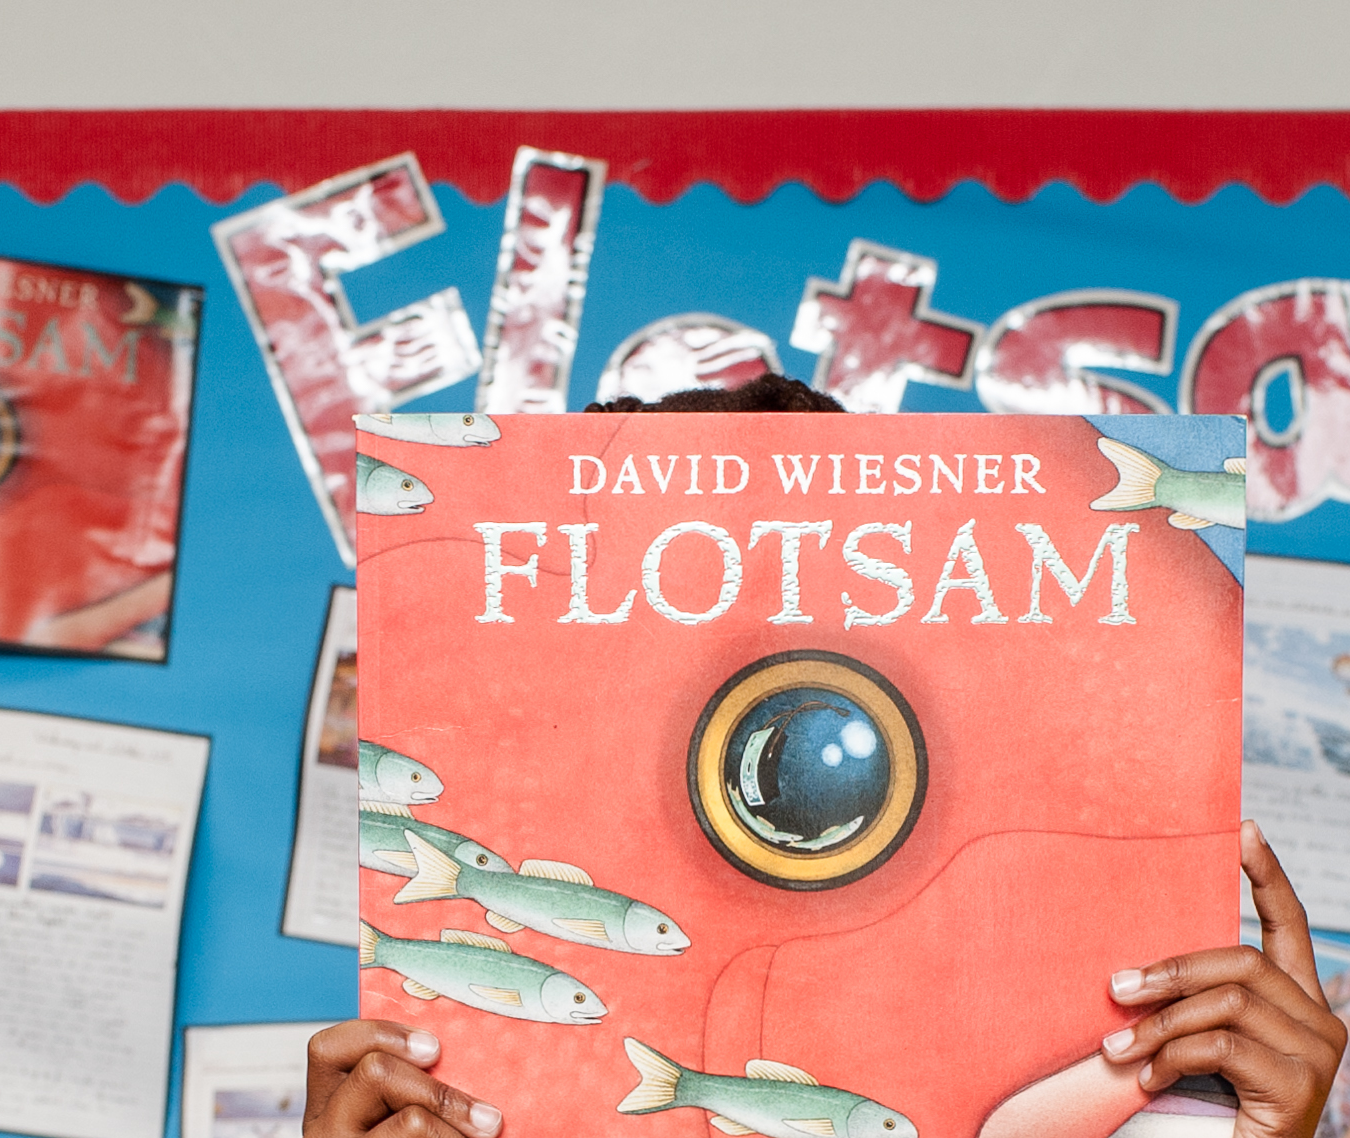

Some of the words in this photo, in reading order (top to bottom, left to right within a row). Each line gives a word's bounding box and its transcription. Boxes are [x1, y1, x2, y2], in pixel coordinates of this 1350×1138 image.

[568, 453, 750, 495] DAVID
[771, 453, 1047, 495] WIESNER
[472, 518, 1141, 630] FLOTSAM
